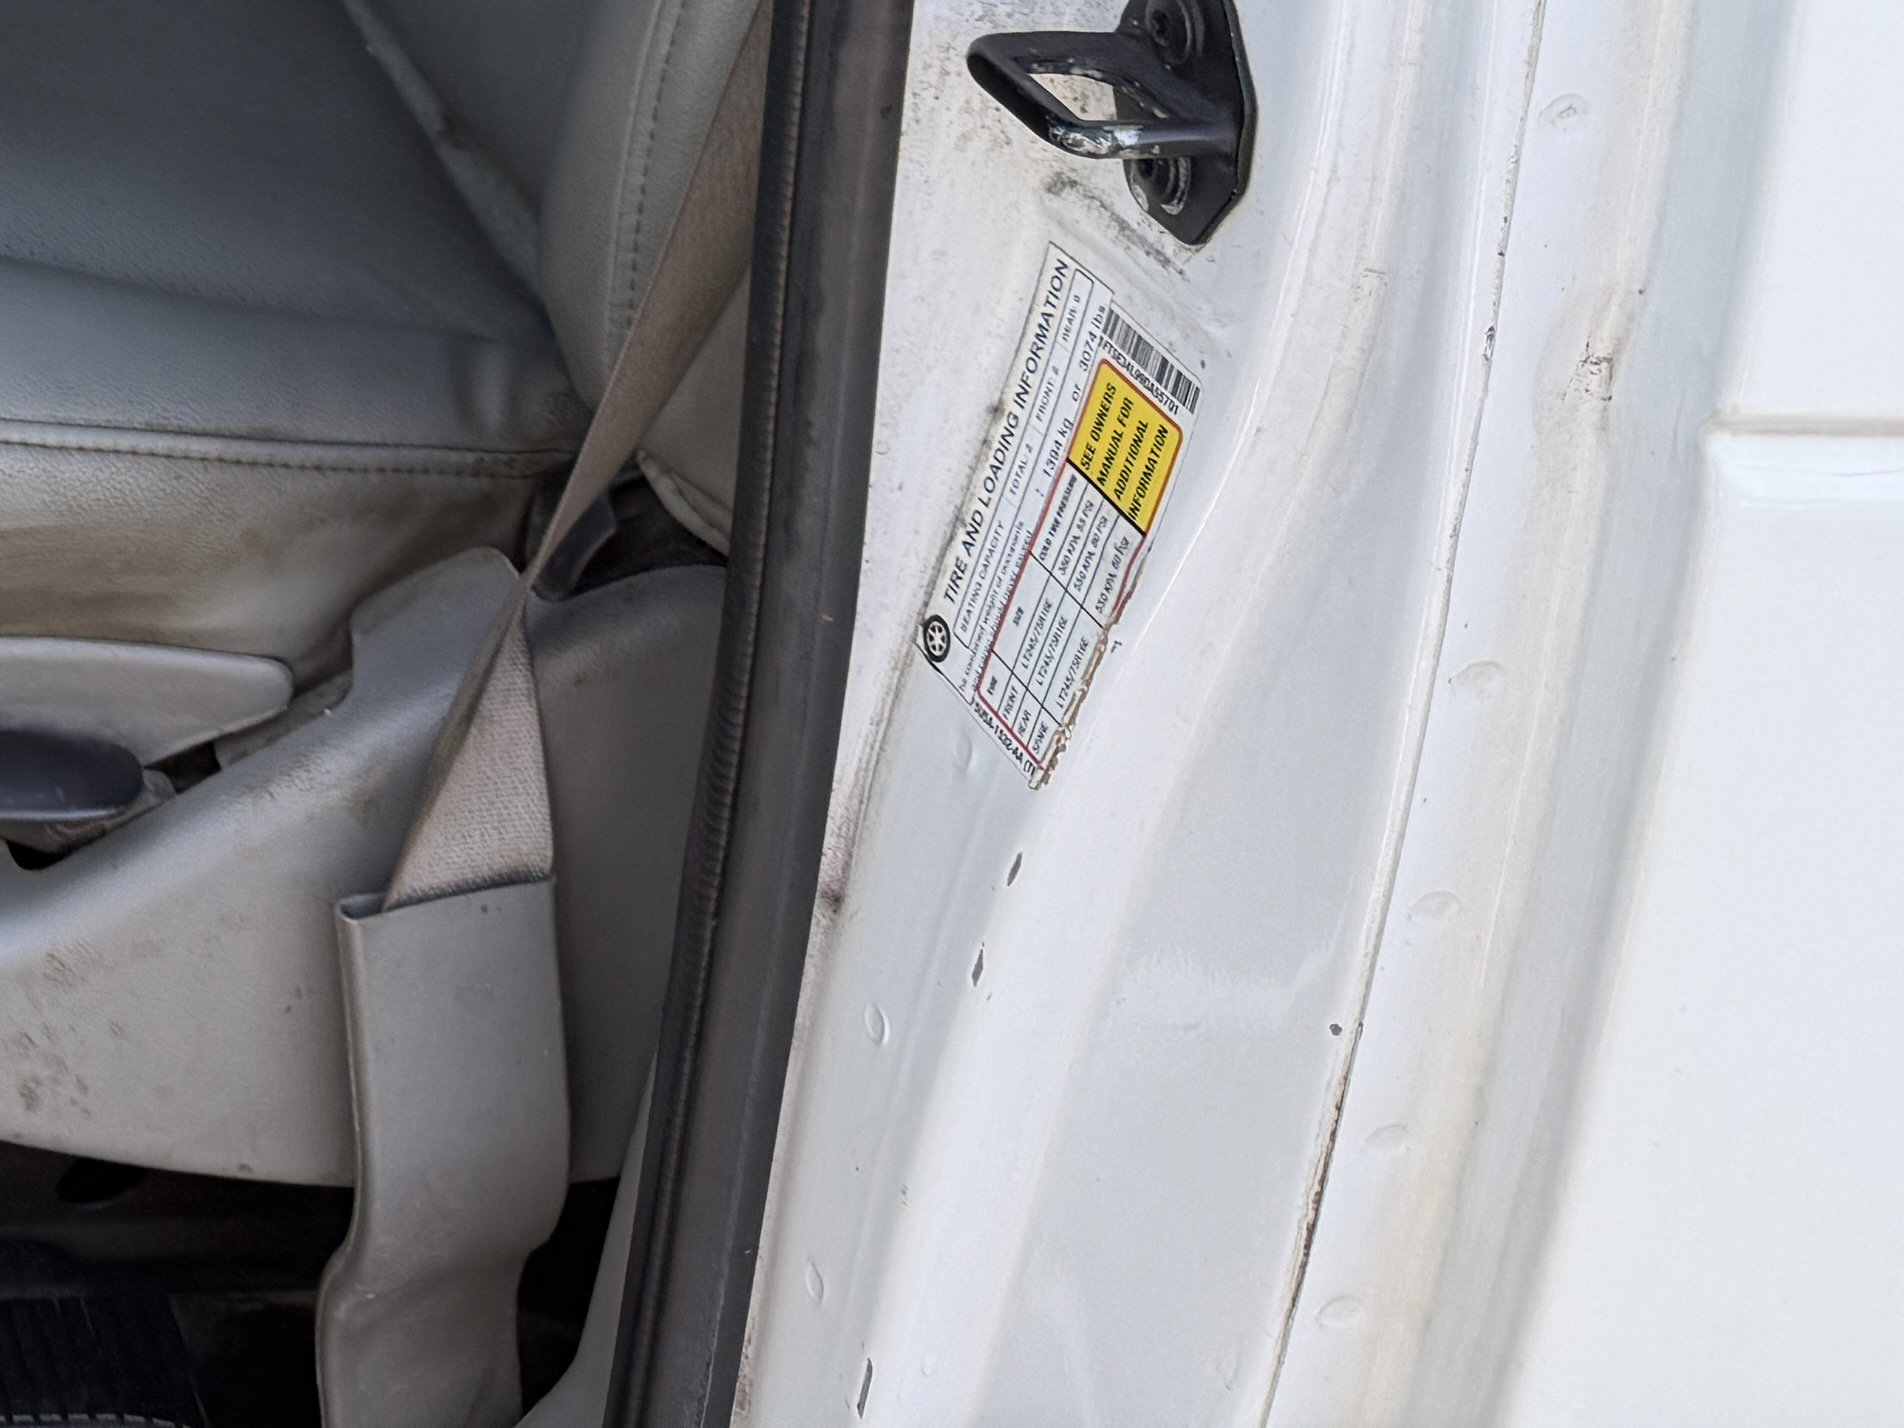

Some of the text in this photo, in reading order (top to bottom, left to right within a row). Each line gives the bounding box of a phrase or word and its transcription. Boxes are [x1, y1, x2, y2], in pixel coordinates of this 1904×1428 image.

[1057, 418, 1073, 437] kg
[1071, 383, 1080, 401] or
[1079, 331, 1096, 371] 3074
[1091, 305, 1105, 329] lbs
[944, 557, 967, 602] TIRE
[962, 510, 983, 556] AND
[978, 412, 1018, 506] LOADING
[1014, 259, 1067, 408] INFORMATION
[1080, 383, 1115, 470] SEE OWNERS
[1097, 397, 1133, 485] MANUAL FOR
[1114, 420, 1147, 499] ADDITIONAL
[1128, 425, 1167, 519] INFORMATION
